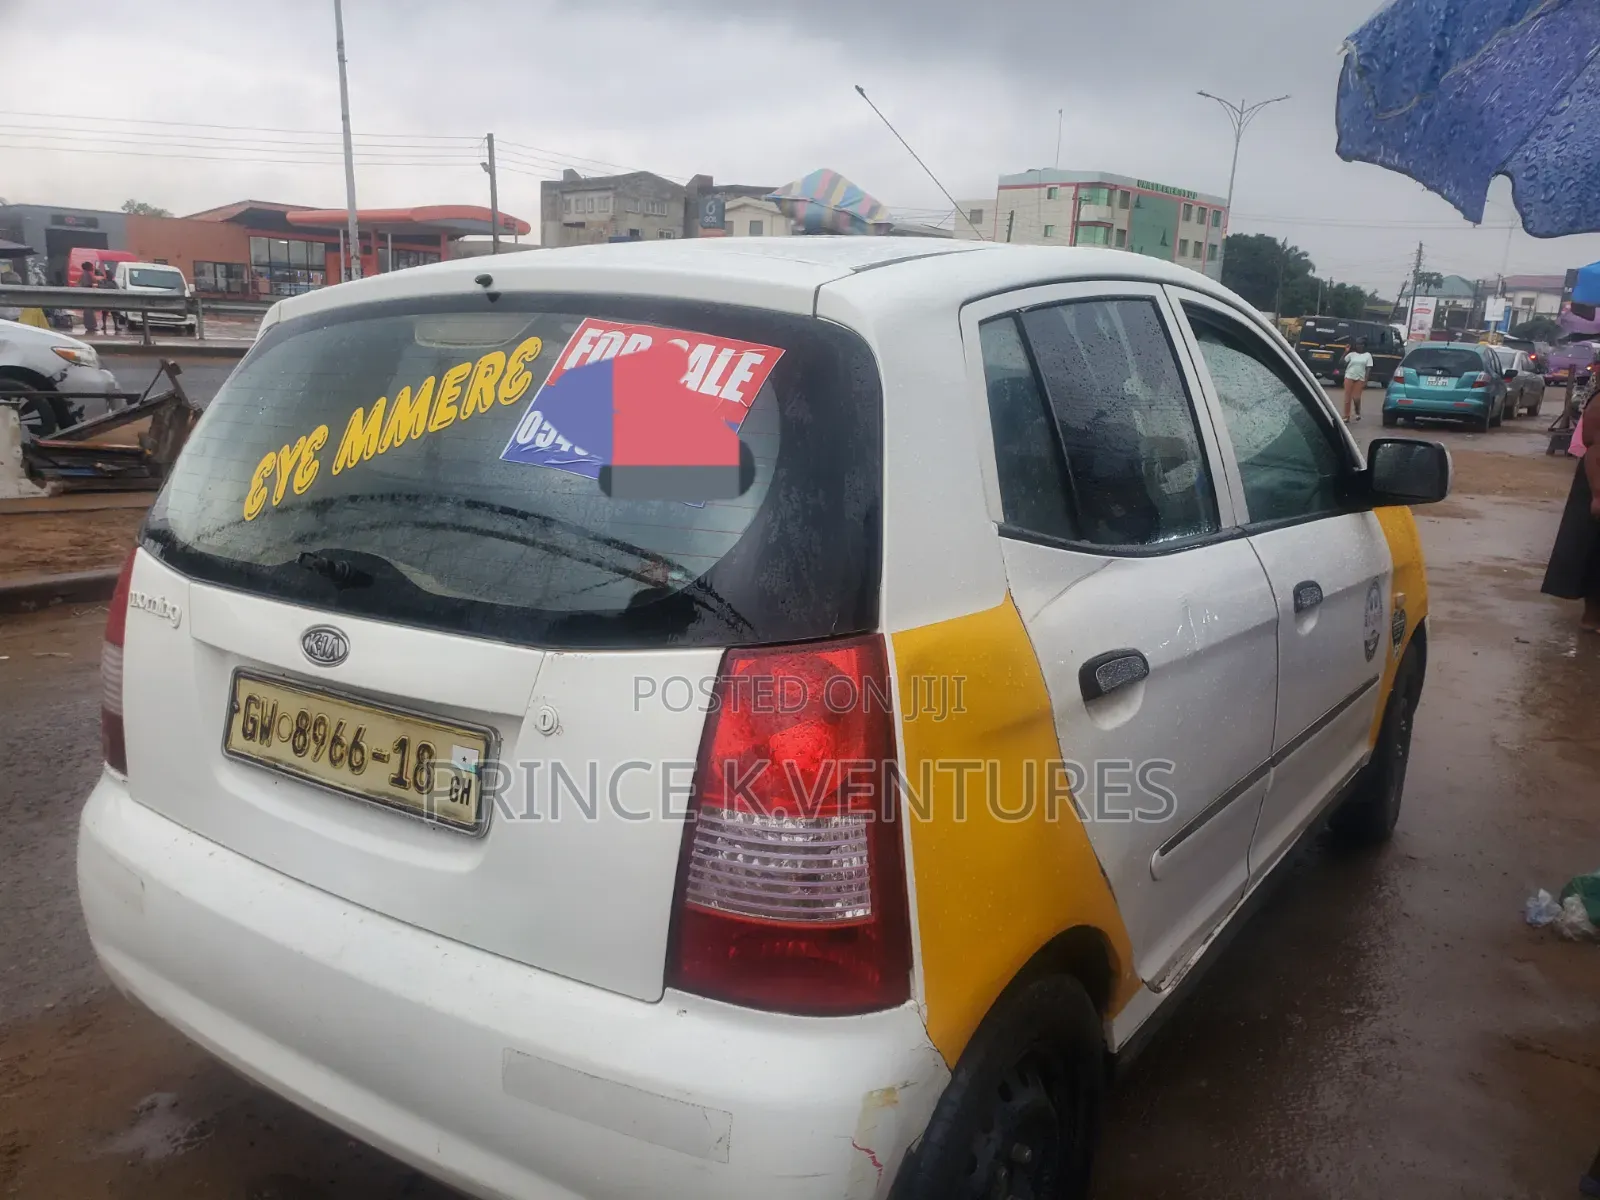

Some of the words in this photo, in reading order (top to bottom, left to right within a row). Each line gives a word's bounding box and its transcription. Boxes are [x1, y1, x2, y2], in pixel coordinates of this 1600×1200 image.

[667, 339, 766, 403] ALE
[304, 630, 341, 661] KIA
[449, 774, 472, 806] GH
